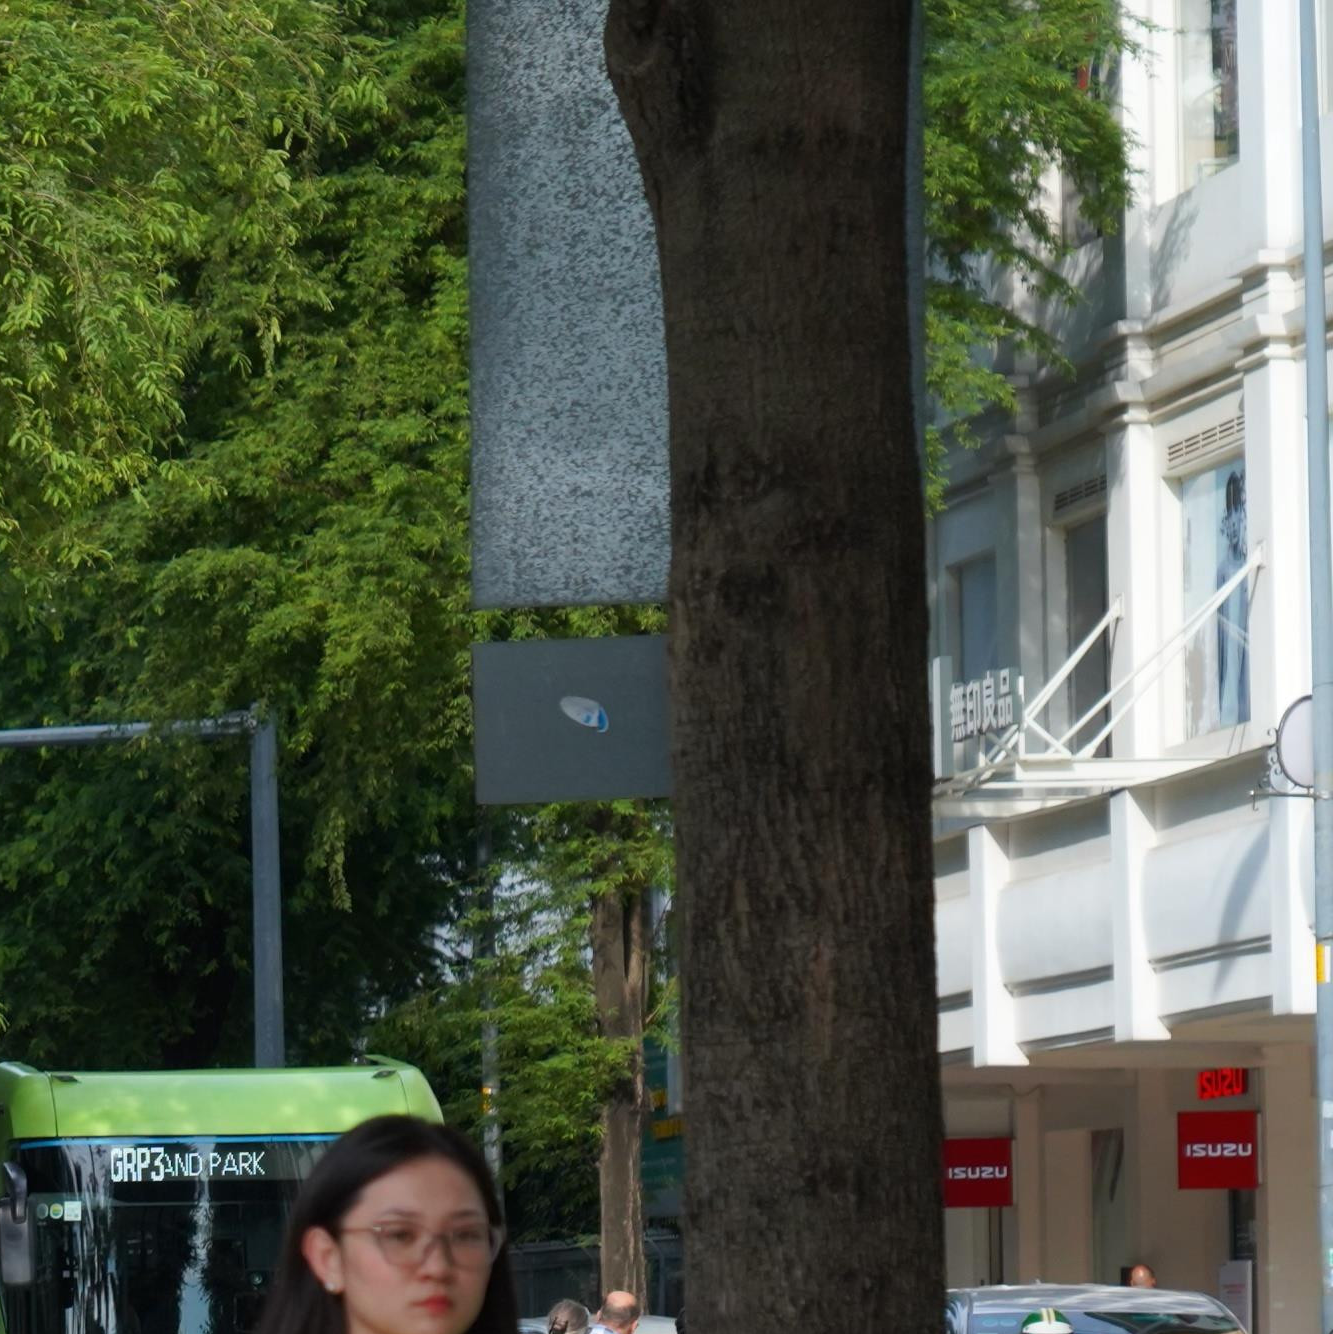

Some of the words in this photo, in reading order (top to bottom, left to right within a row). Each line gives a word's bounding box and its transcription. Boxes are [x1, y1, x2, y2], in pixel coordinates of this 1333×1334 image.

[949, 668, 1014, 742] 無印良品
[1197, 1066, 1247, 1101] ISUZU
[110, 1147, 165, 1183] GRP3
[209, 1151, 266, 1176] PARK
[1185, 1142, 1252, 1158] ISUZU
[948, 1165, 1008, 1180] ISUZU
